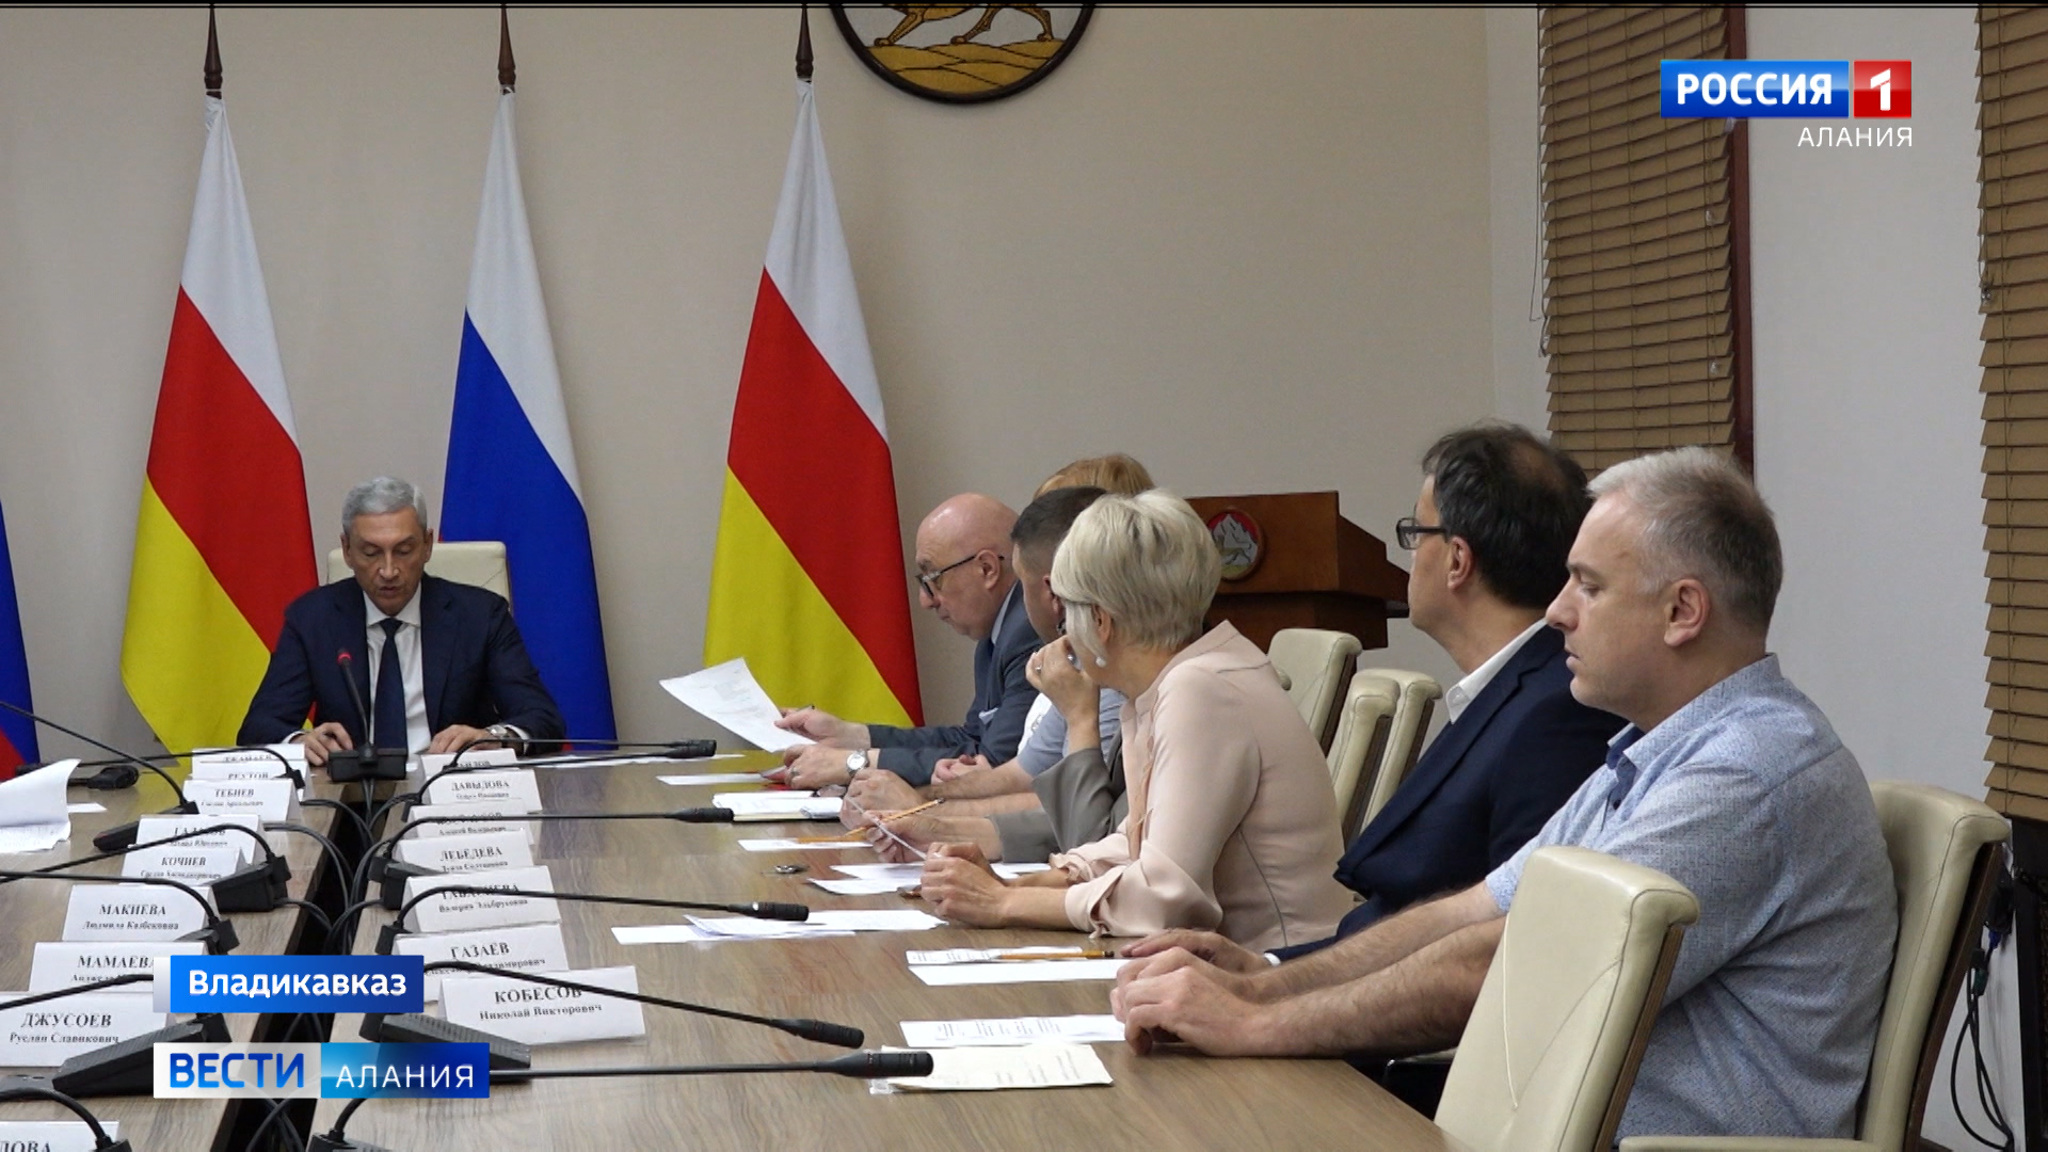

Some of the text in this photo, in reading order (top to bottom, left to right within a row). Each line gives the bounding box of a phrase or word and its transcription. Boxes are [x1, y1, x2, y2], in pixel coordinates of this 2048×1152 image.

[451, 780, 510, 792] ДАВЫДОВА
[215, 788, 254, 798] ТЕБИЕВ
[440, 846, 503, 862] ЛЕБЕДЕВА
[161, 856, 207, 867] КОЧИЕВ
[98, 904, 166, 915] МАКИЕВА
[127, 920, 179, 931] Казбековна
[450, 942, 510, 959] ГАЗАЕВ
[77, 955, 154, 969] МАМАЕВ
[495, 987, 582, 1004] КОБЕСОВ
[480, 1004, 602, 1021] Николай Викторович
[21, 1013, 112, 1028] ДЖУСОЕВ
[9, 1033, 119, 1044] Руслан Славикович
